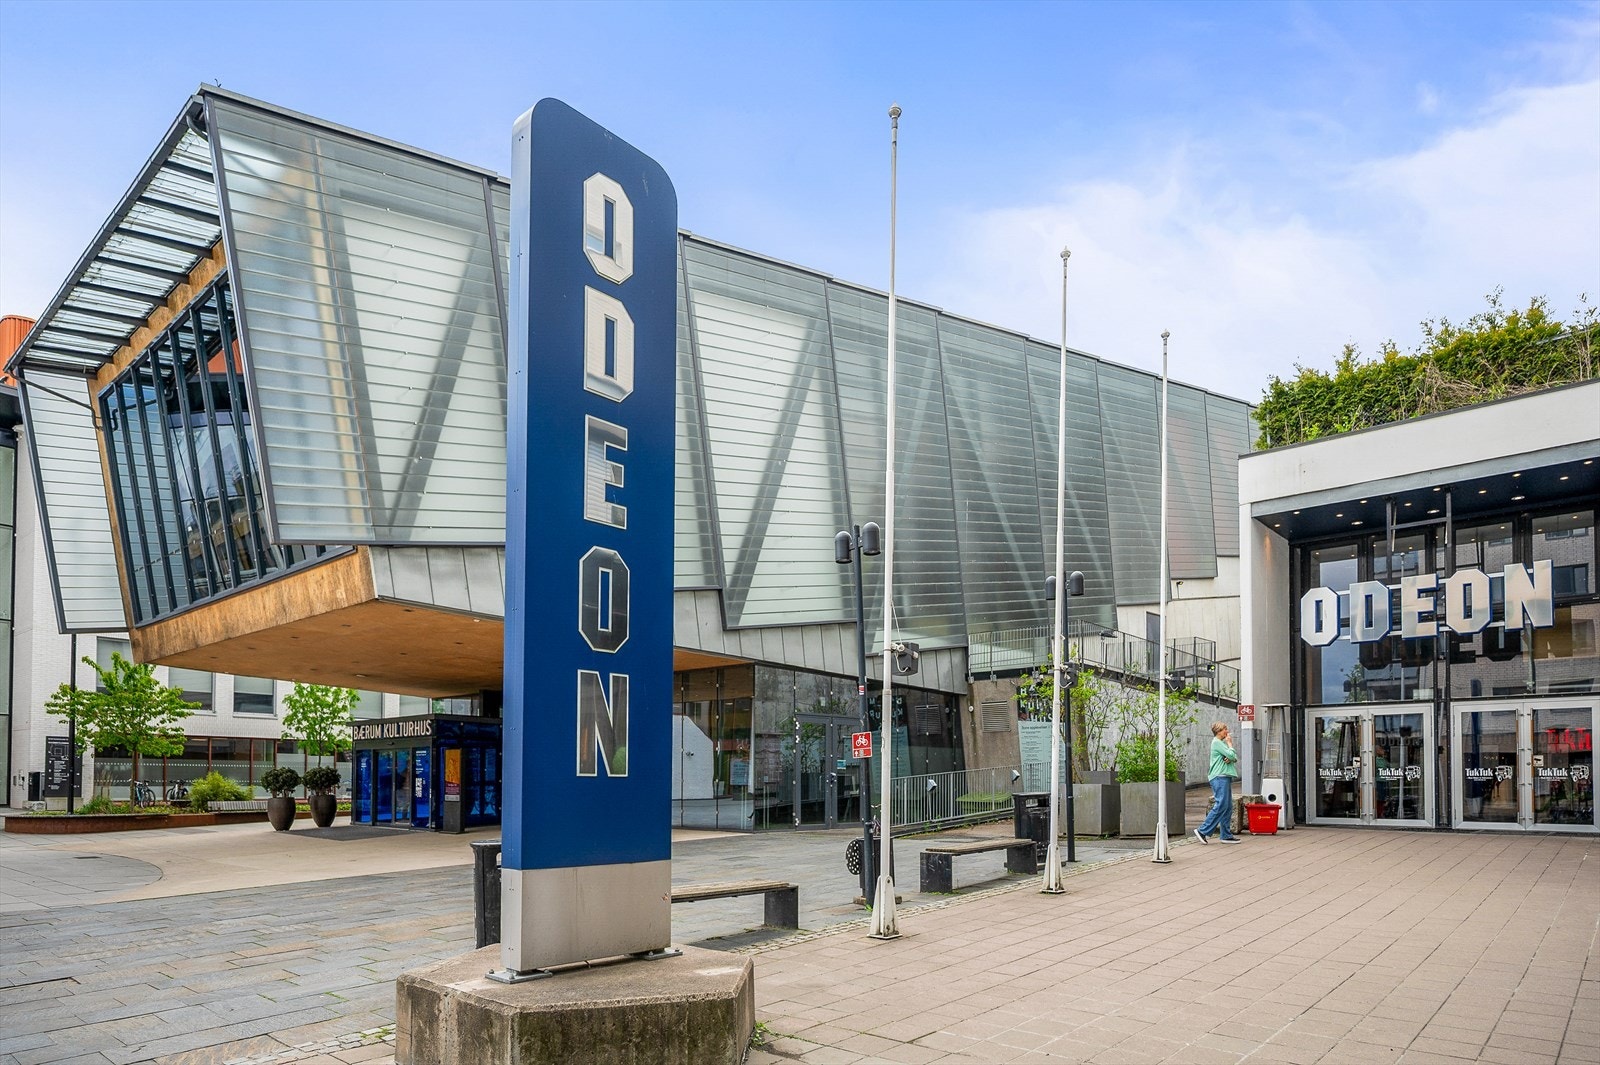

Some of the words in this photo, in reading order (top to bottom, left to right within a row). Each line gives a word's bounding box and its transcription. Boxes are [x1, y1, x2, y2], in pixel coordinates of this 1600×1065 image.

[576, 171, 635, 778] ODEON
[1300, 559, 1554, 647] ODEON
[353, 723, 382, 740] BÆRUM
[383, 719, 432, 738] KULTURHUS
[1318, 768, 1343, 776] TukTuk
[1378, 768, 1404, 776] TukTuk
[1464, 768, 1494, 777] TukTuk
[1537, 767, 1568, 777] TukTuk
